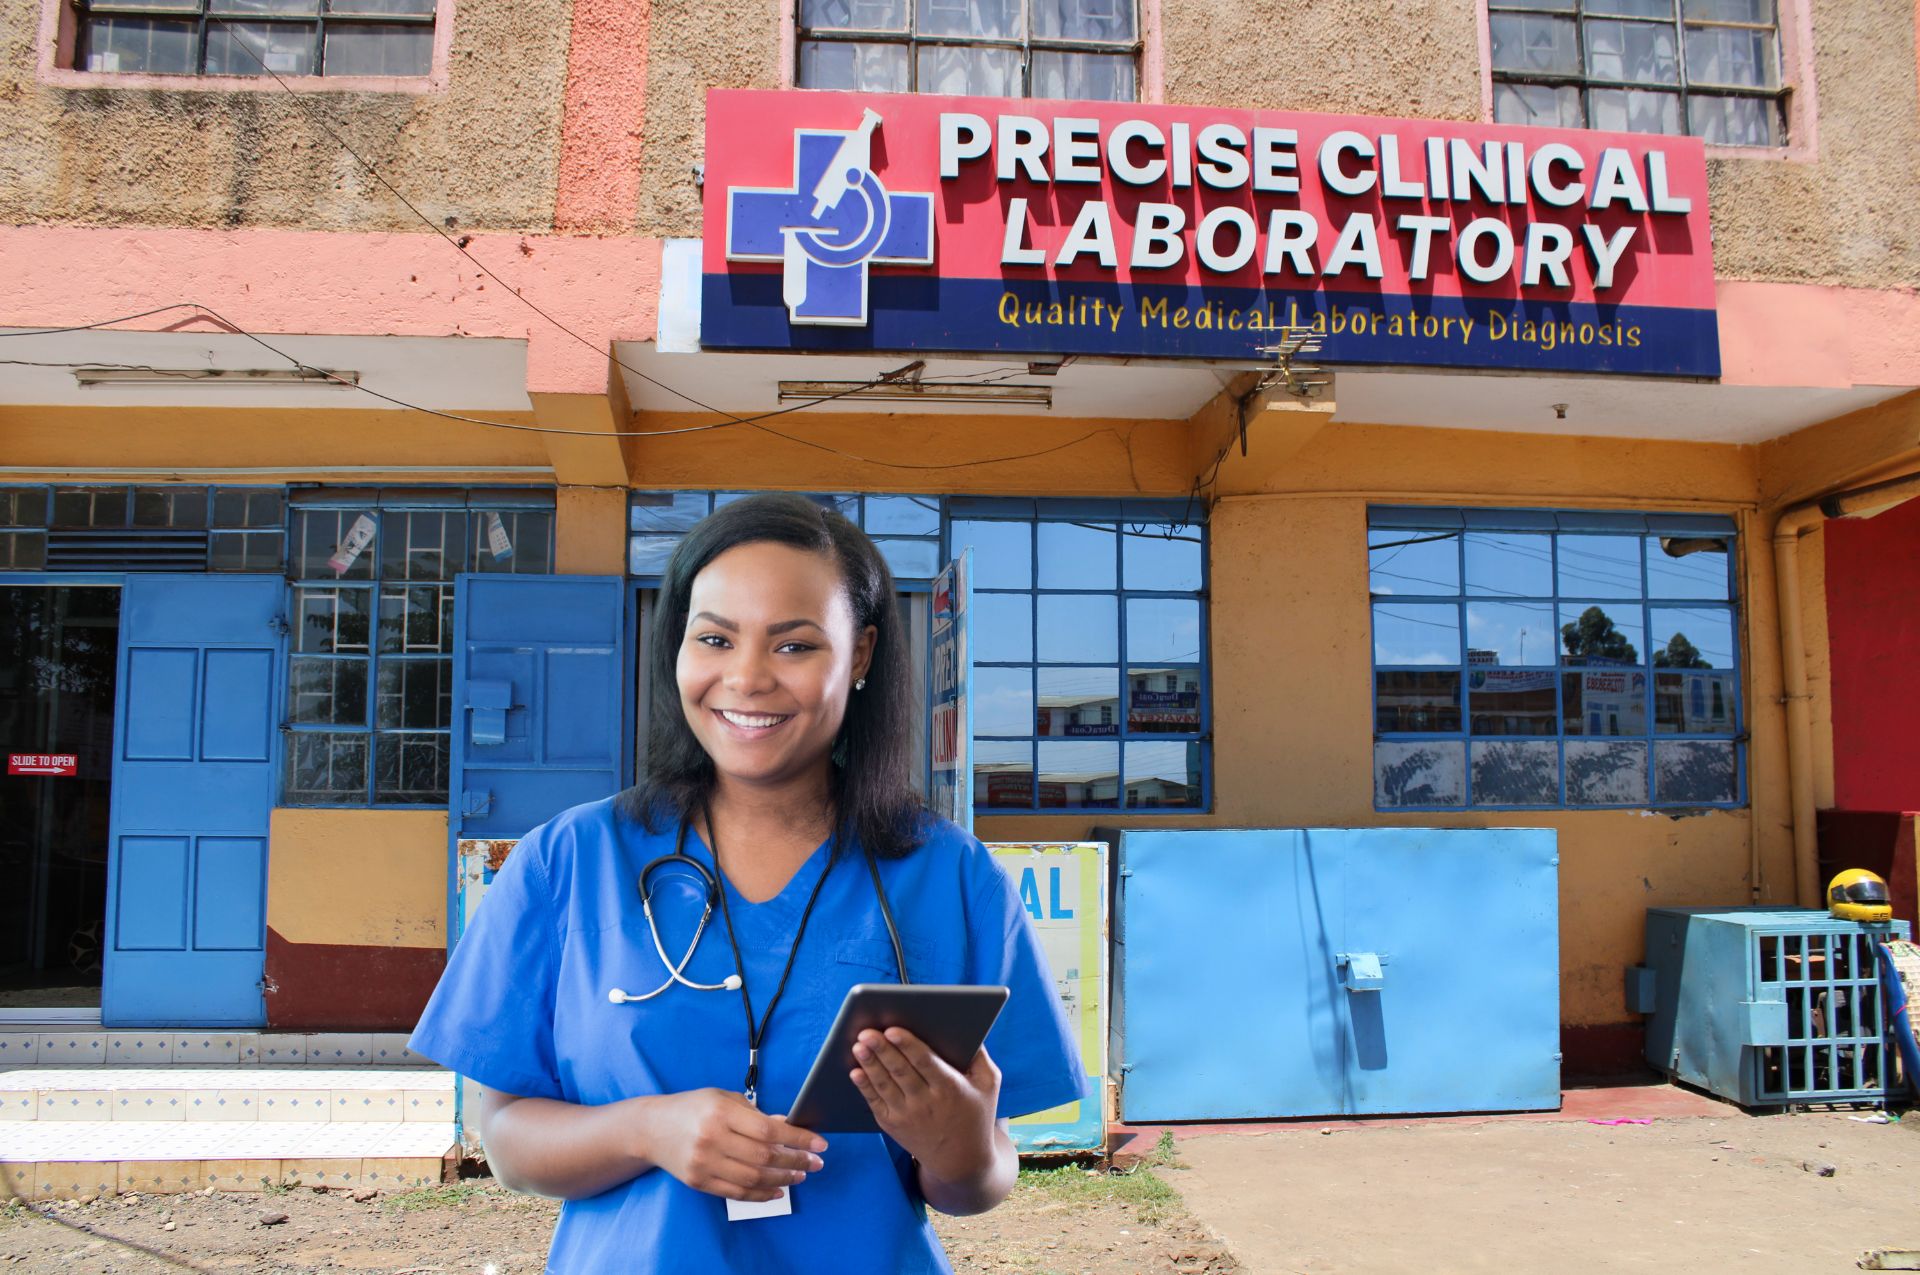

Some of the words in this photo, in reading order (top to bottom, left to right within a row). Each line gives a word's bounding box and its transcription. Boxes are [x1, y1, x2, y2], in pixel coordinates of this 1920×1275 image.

[940, 112, 1300, 192] PRECISE
[1318, 130, 1692, 215] CLINICAL
[1000, 197, 1638, 291] LABORATORY
[998, 291, 1125, 333] Quality
[1140, 295, 1274, 331] Medical
[1290, 302, 1476, 345] Laboratory
[1488, 309, 1643, 351] Diagnosis
[12, 755, 37, 766] SLIDE
[38, 755, 50, 766] TO
[52, 756, 75, 767] OPEN
